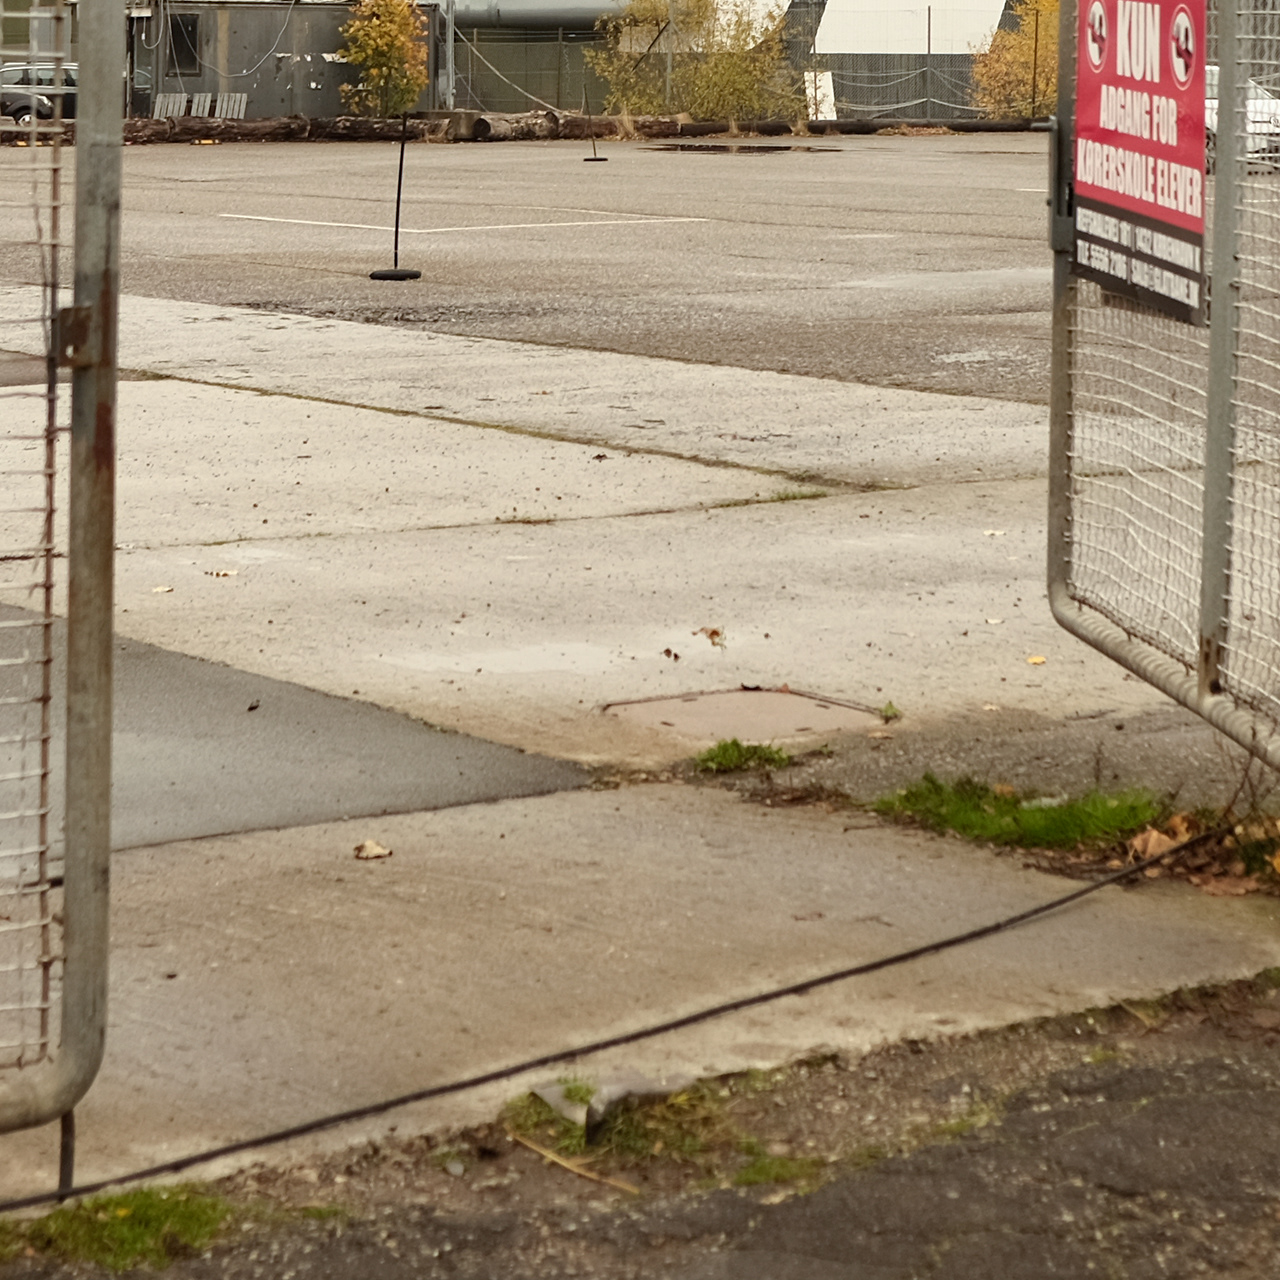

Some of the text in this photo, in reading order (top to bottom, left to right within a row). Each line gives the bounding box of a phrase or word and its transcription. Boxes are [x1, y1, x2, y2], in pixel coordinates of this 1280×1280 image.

[1116, 0, 1161, 84] KUN
[1099, 83, 1178, 147] ADGANG FOR
[1156, 157, 1203, 219] ELEVER
